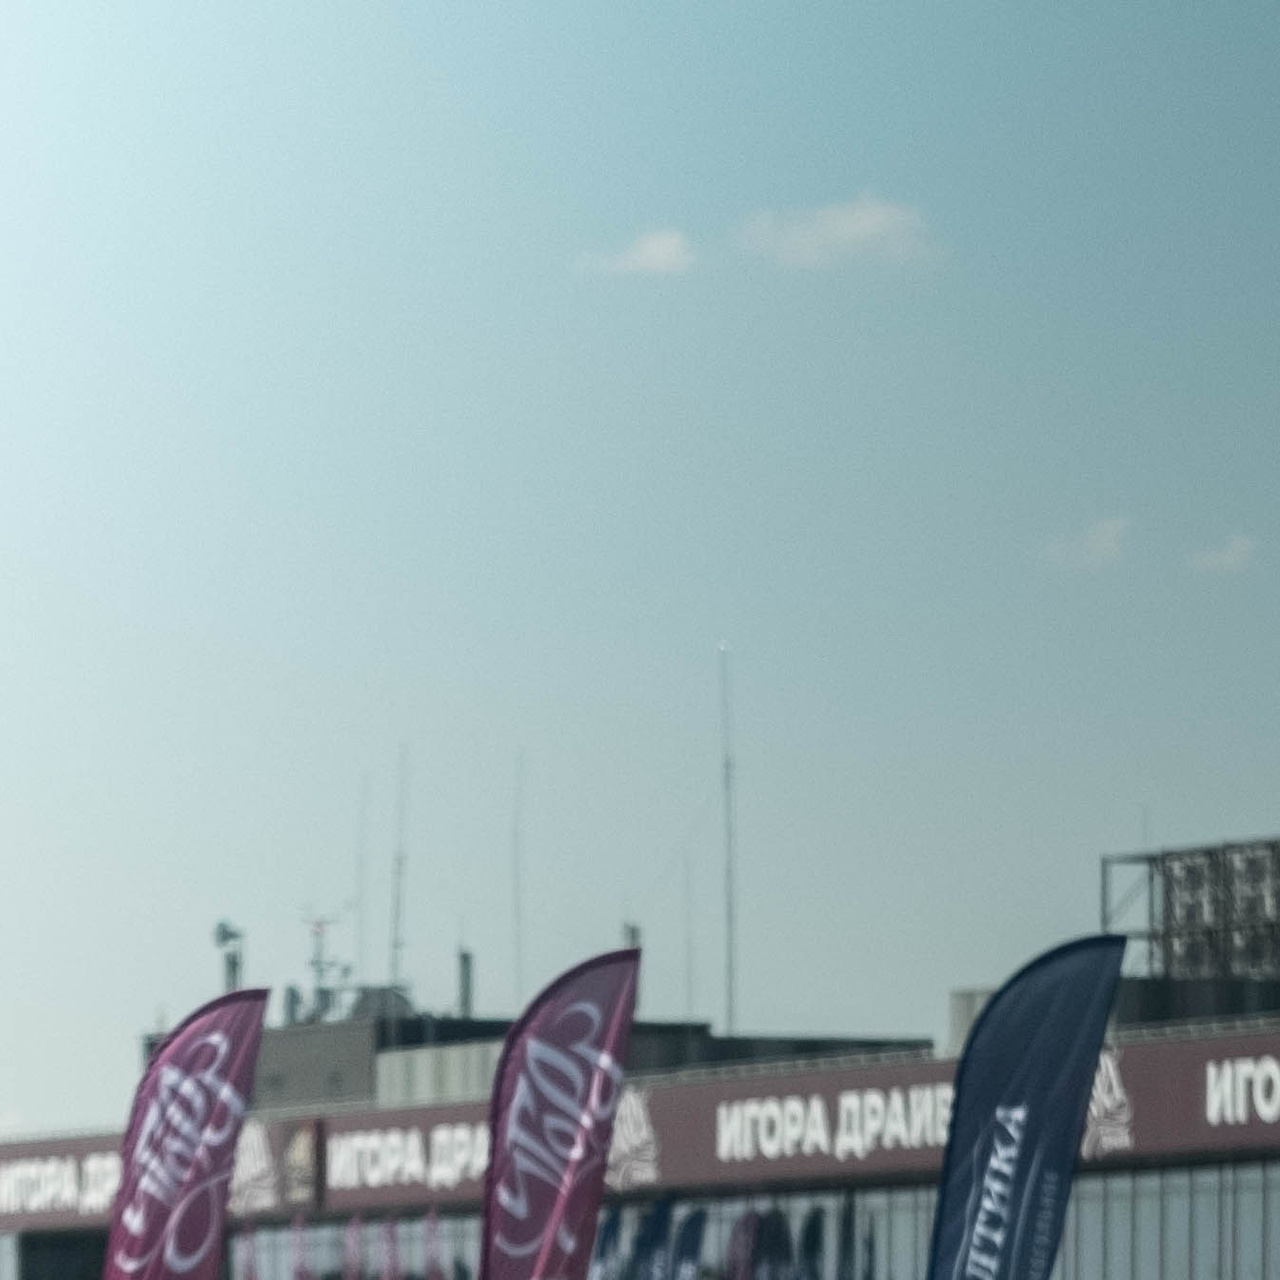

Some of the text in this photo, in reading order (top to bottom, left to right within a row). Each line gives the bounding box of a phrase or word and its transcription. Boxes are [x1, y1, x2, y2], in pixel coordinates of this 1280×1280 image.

[1206, 1056, 1280, 1127] ИГО
[327, 1129, 424, 1189] ИГОРА
[716, 1095, 829, 1163] ИГОРА
